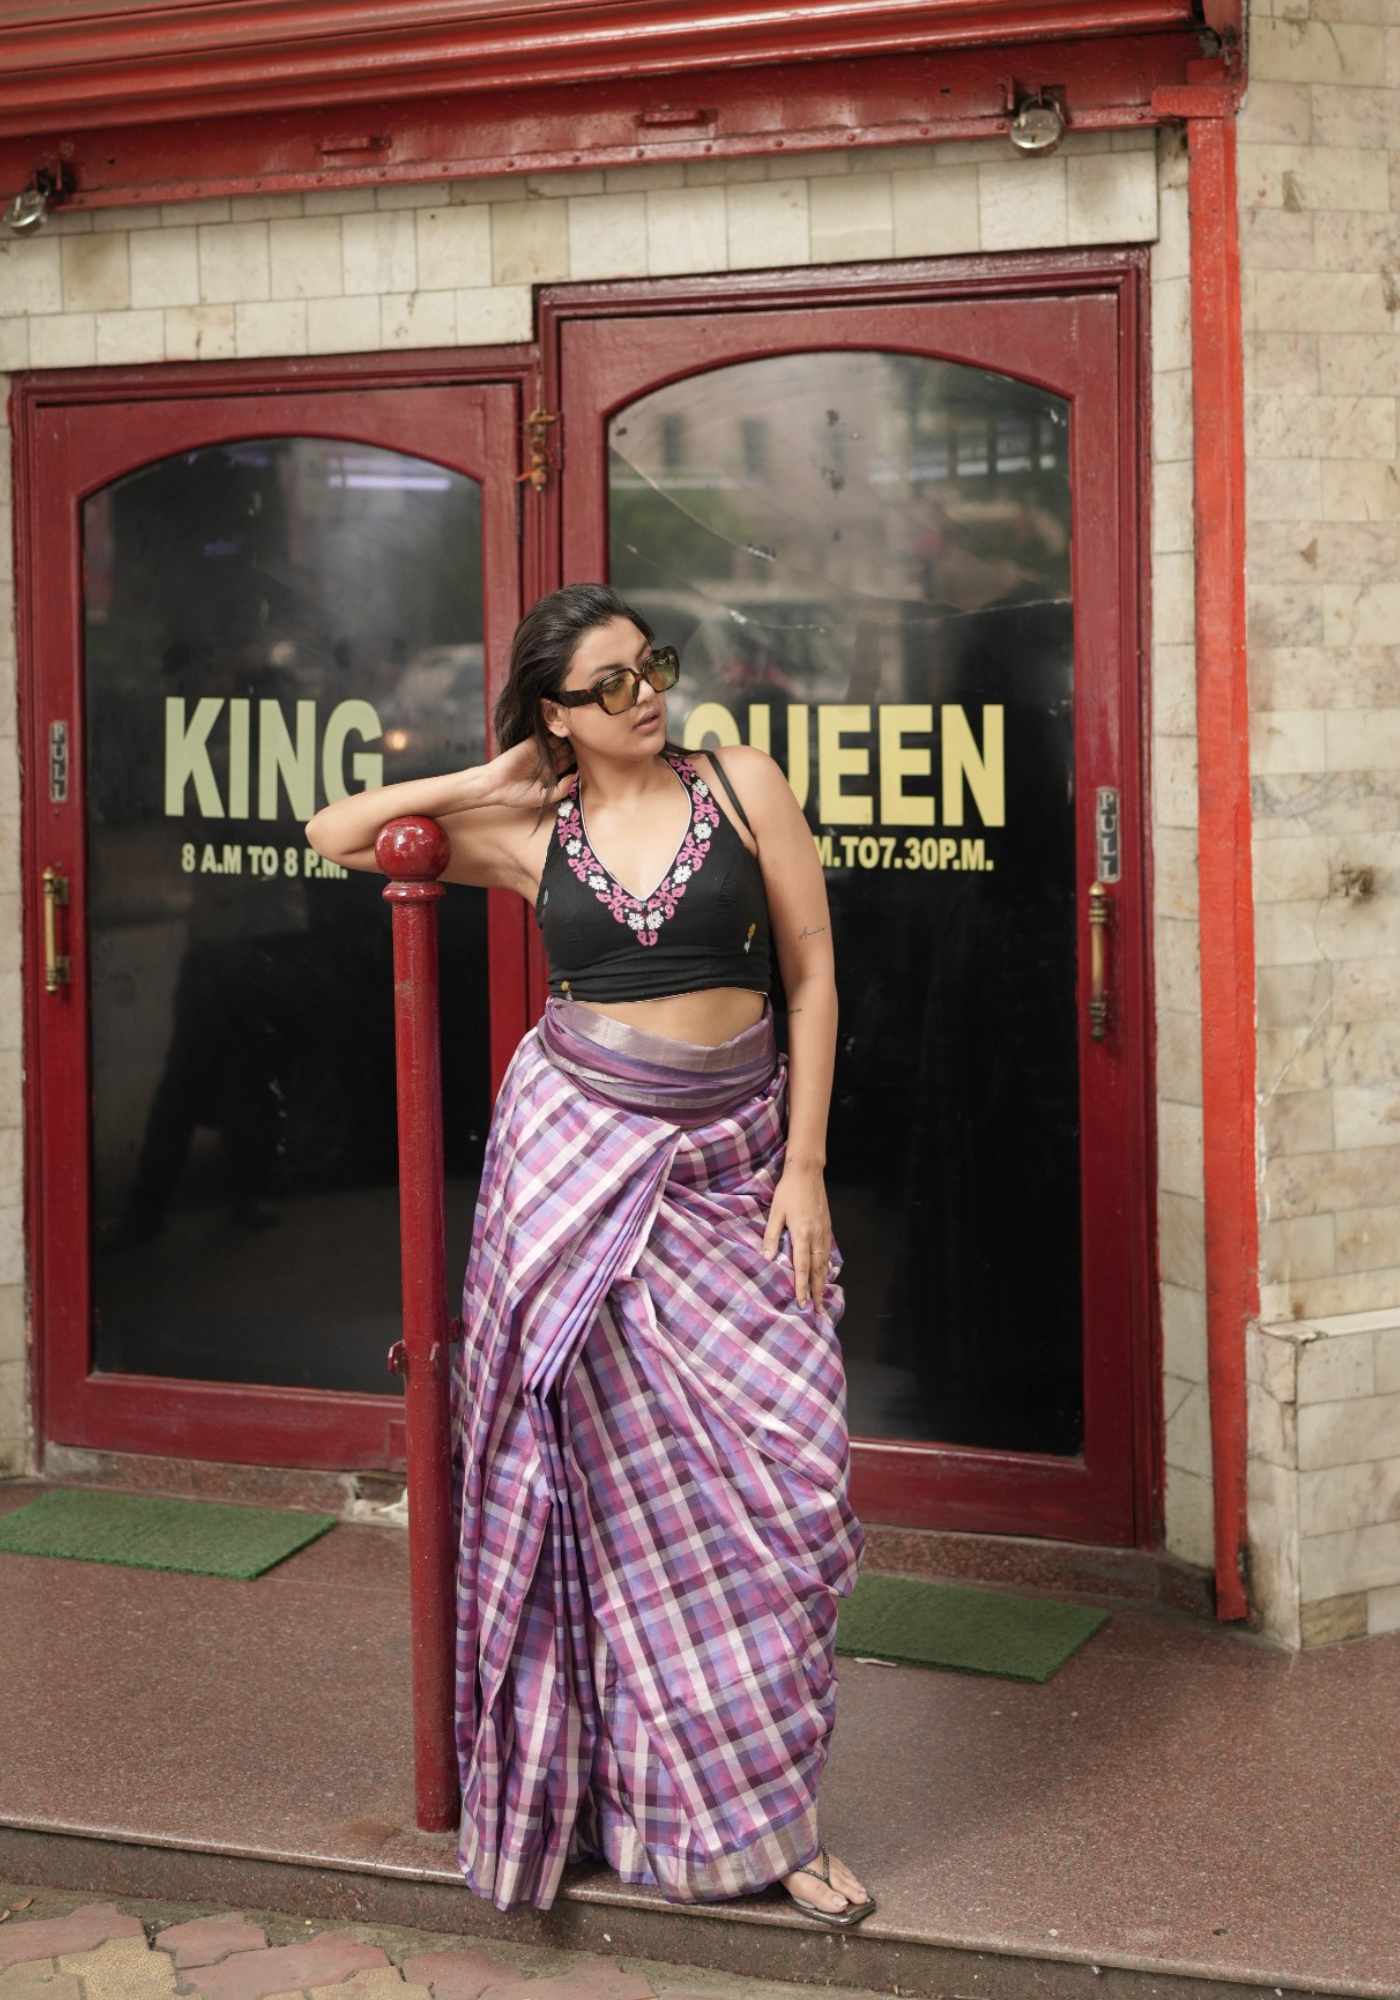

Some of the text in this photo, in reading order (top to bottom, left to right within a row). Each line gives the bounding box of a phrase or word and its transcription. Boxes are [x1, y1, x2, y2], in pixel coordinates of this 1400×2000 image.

[51, 723, 65, 801] PULL
[164, 696, 384, 822] KING
[181, 842, 196, 873] 8
[200, 843, 242, 875] A.M
[246, 845, 279, 876] TO
[283, 846, 299, 878] 8
[1099, 791, 1117, 880] PULL
